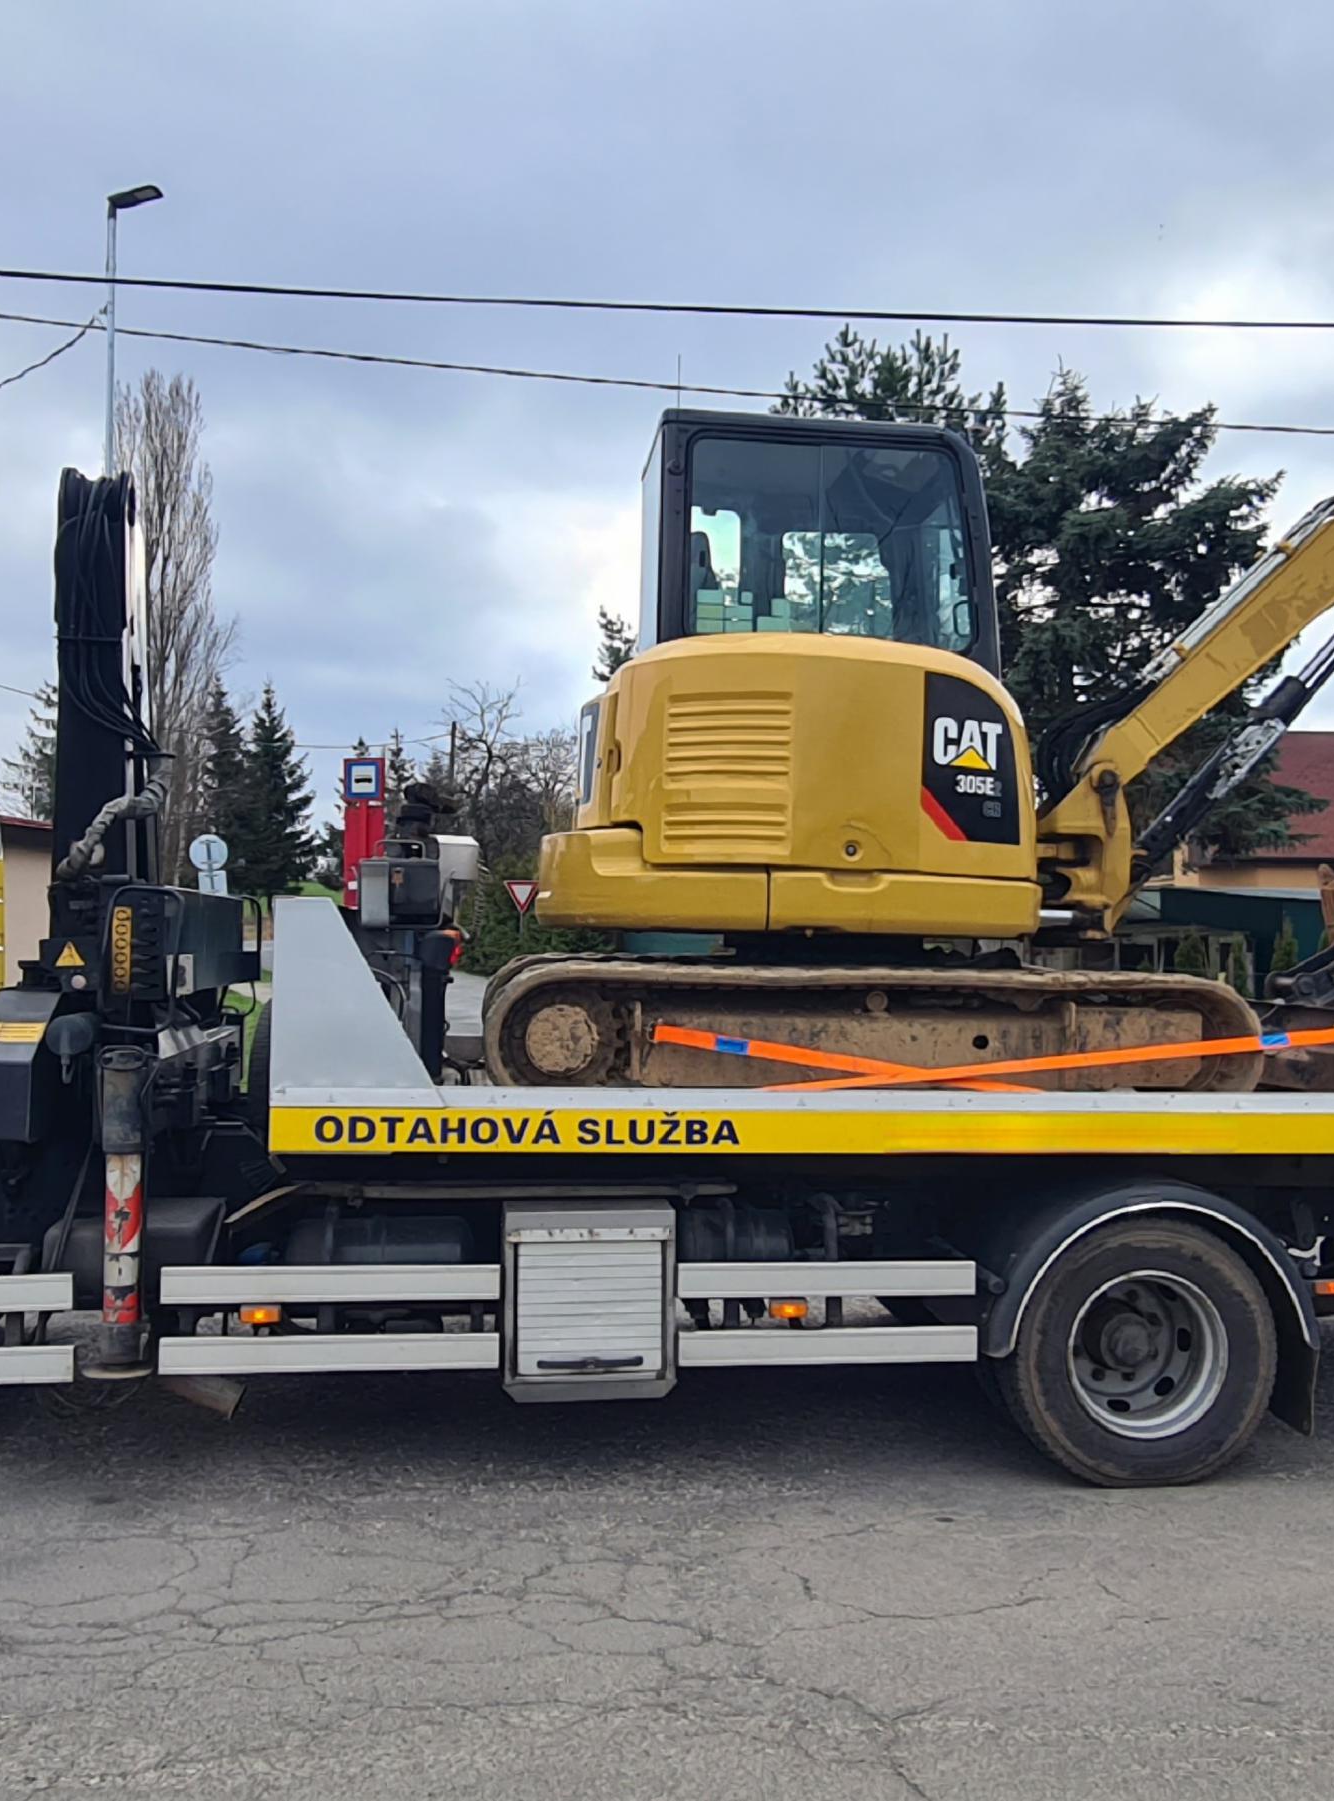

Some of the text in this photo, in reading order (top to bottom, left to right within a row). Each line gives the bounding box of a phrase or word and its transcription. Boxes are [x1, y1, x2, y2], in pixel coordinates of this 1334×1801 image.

[933, 717, 1003, 771] CAT
[314, 1109, 741, 1146] ODTAHOVÁ SLUŽBA
